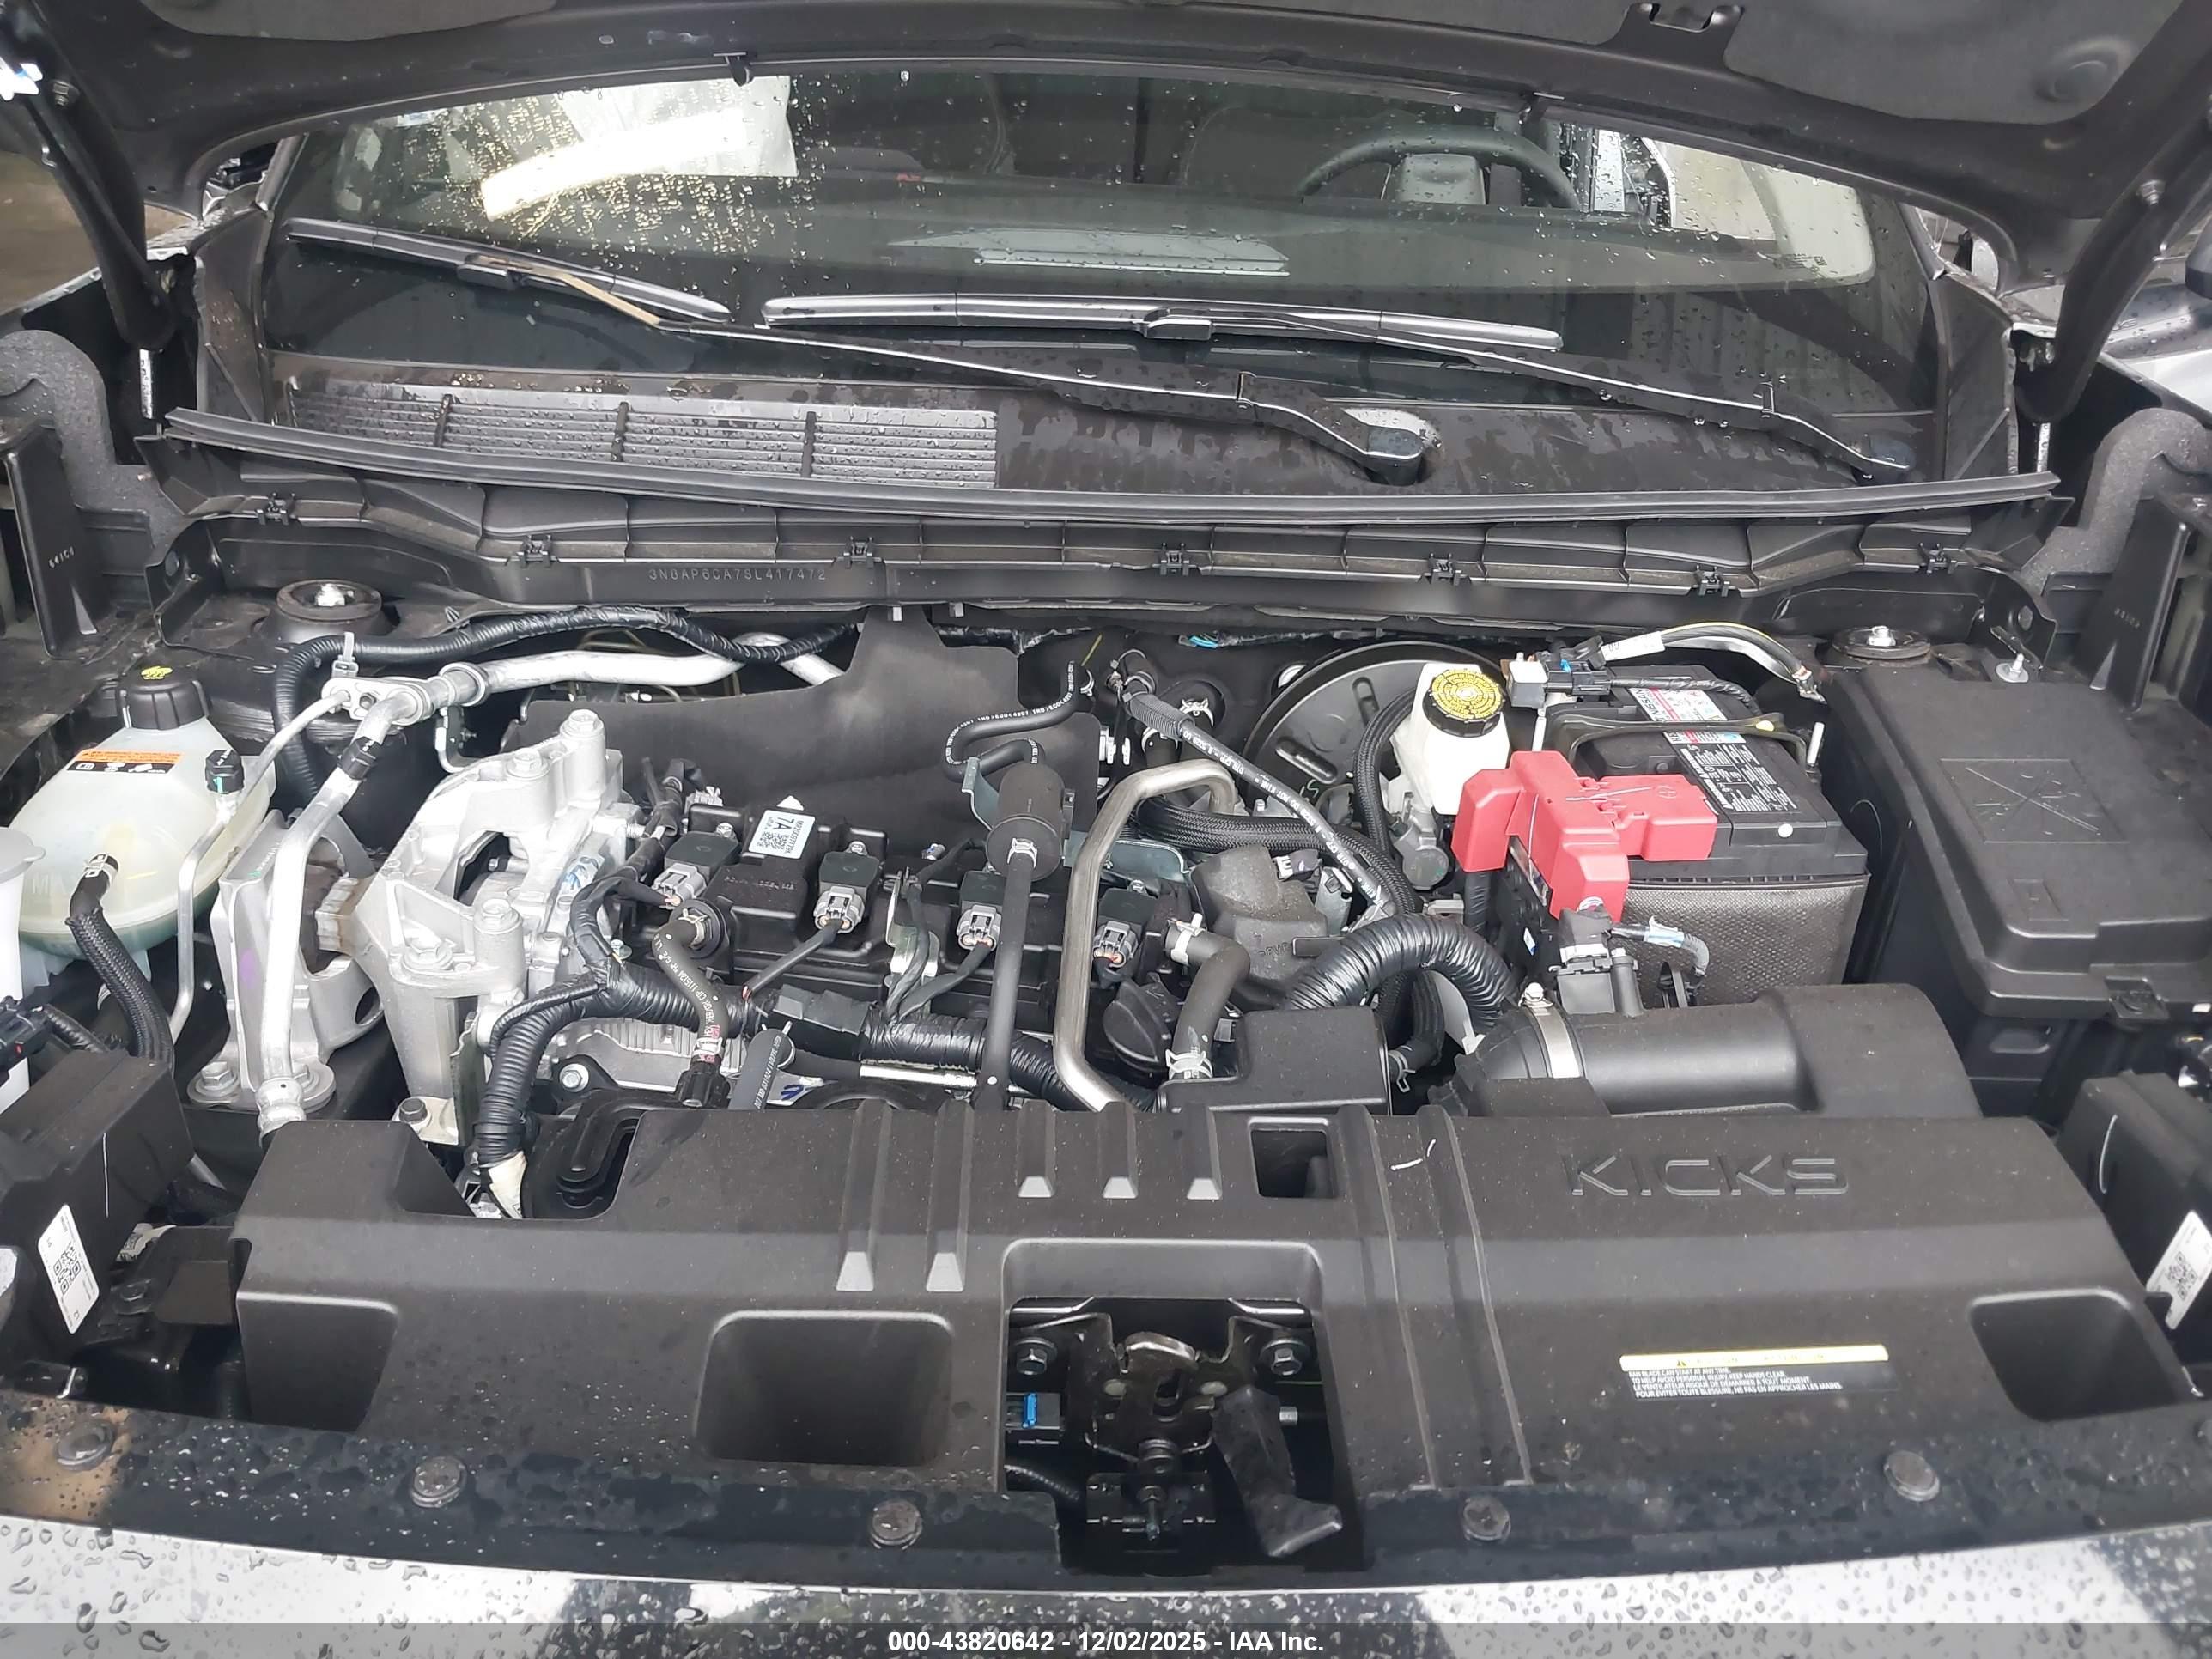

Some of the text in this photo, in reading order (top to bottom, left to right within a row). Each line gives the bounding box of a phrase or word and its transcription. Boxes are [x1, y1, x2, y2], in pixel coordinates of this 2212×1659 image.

[1633, 688, 1659, 715] NISSAN
[1260, 779, 1277, 794] KINK
[1277, 790, 1291, 803] NOT
[772, 817, 795, 830] 7A
[1562, 1154, 1849, 1196] KICKS
